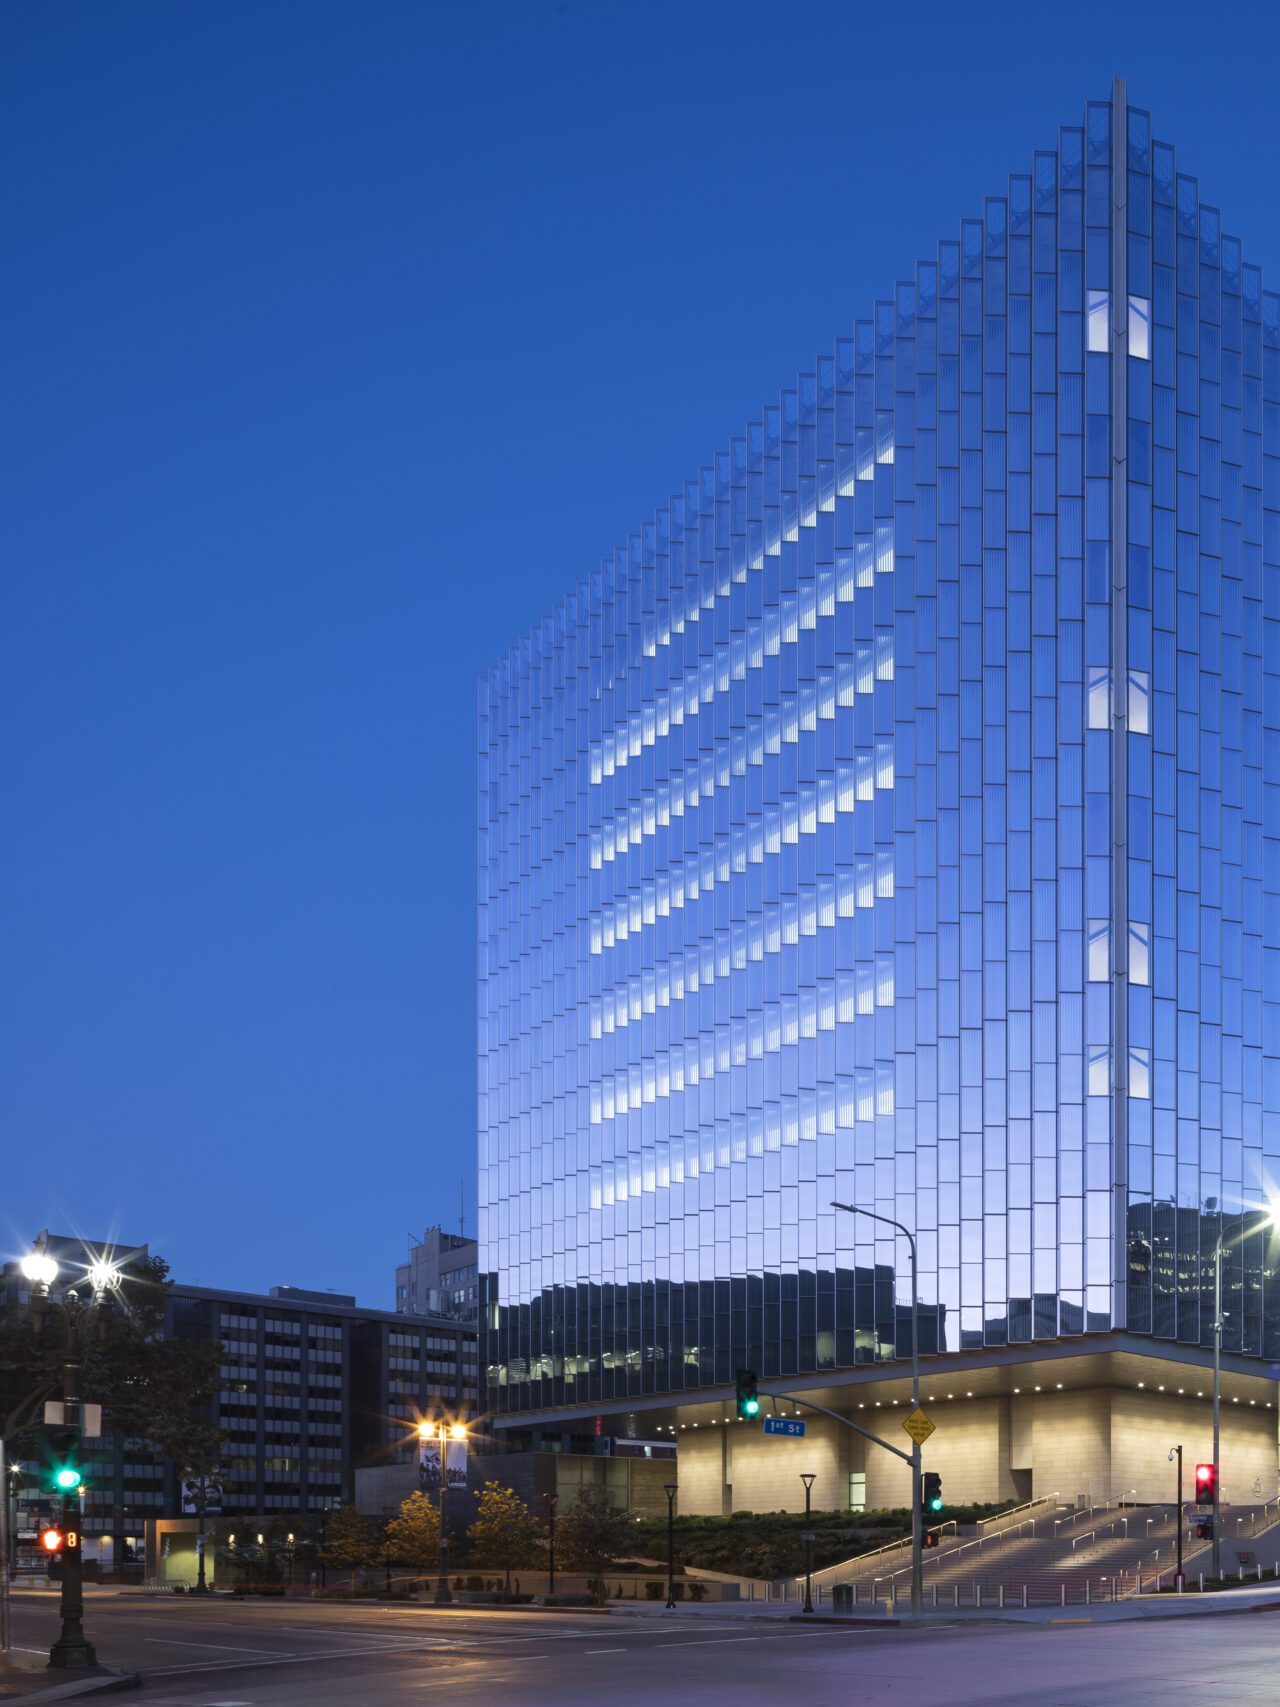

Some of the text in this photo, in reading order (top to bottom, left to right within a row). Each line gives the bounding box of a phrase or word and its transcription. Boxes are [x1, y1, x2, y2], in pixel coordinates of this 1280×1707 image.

[770, 1421, 800, 1434] 1st St
[67, 1531, 77, 1548] 8
